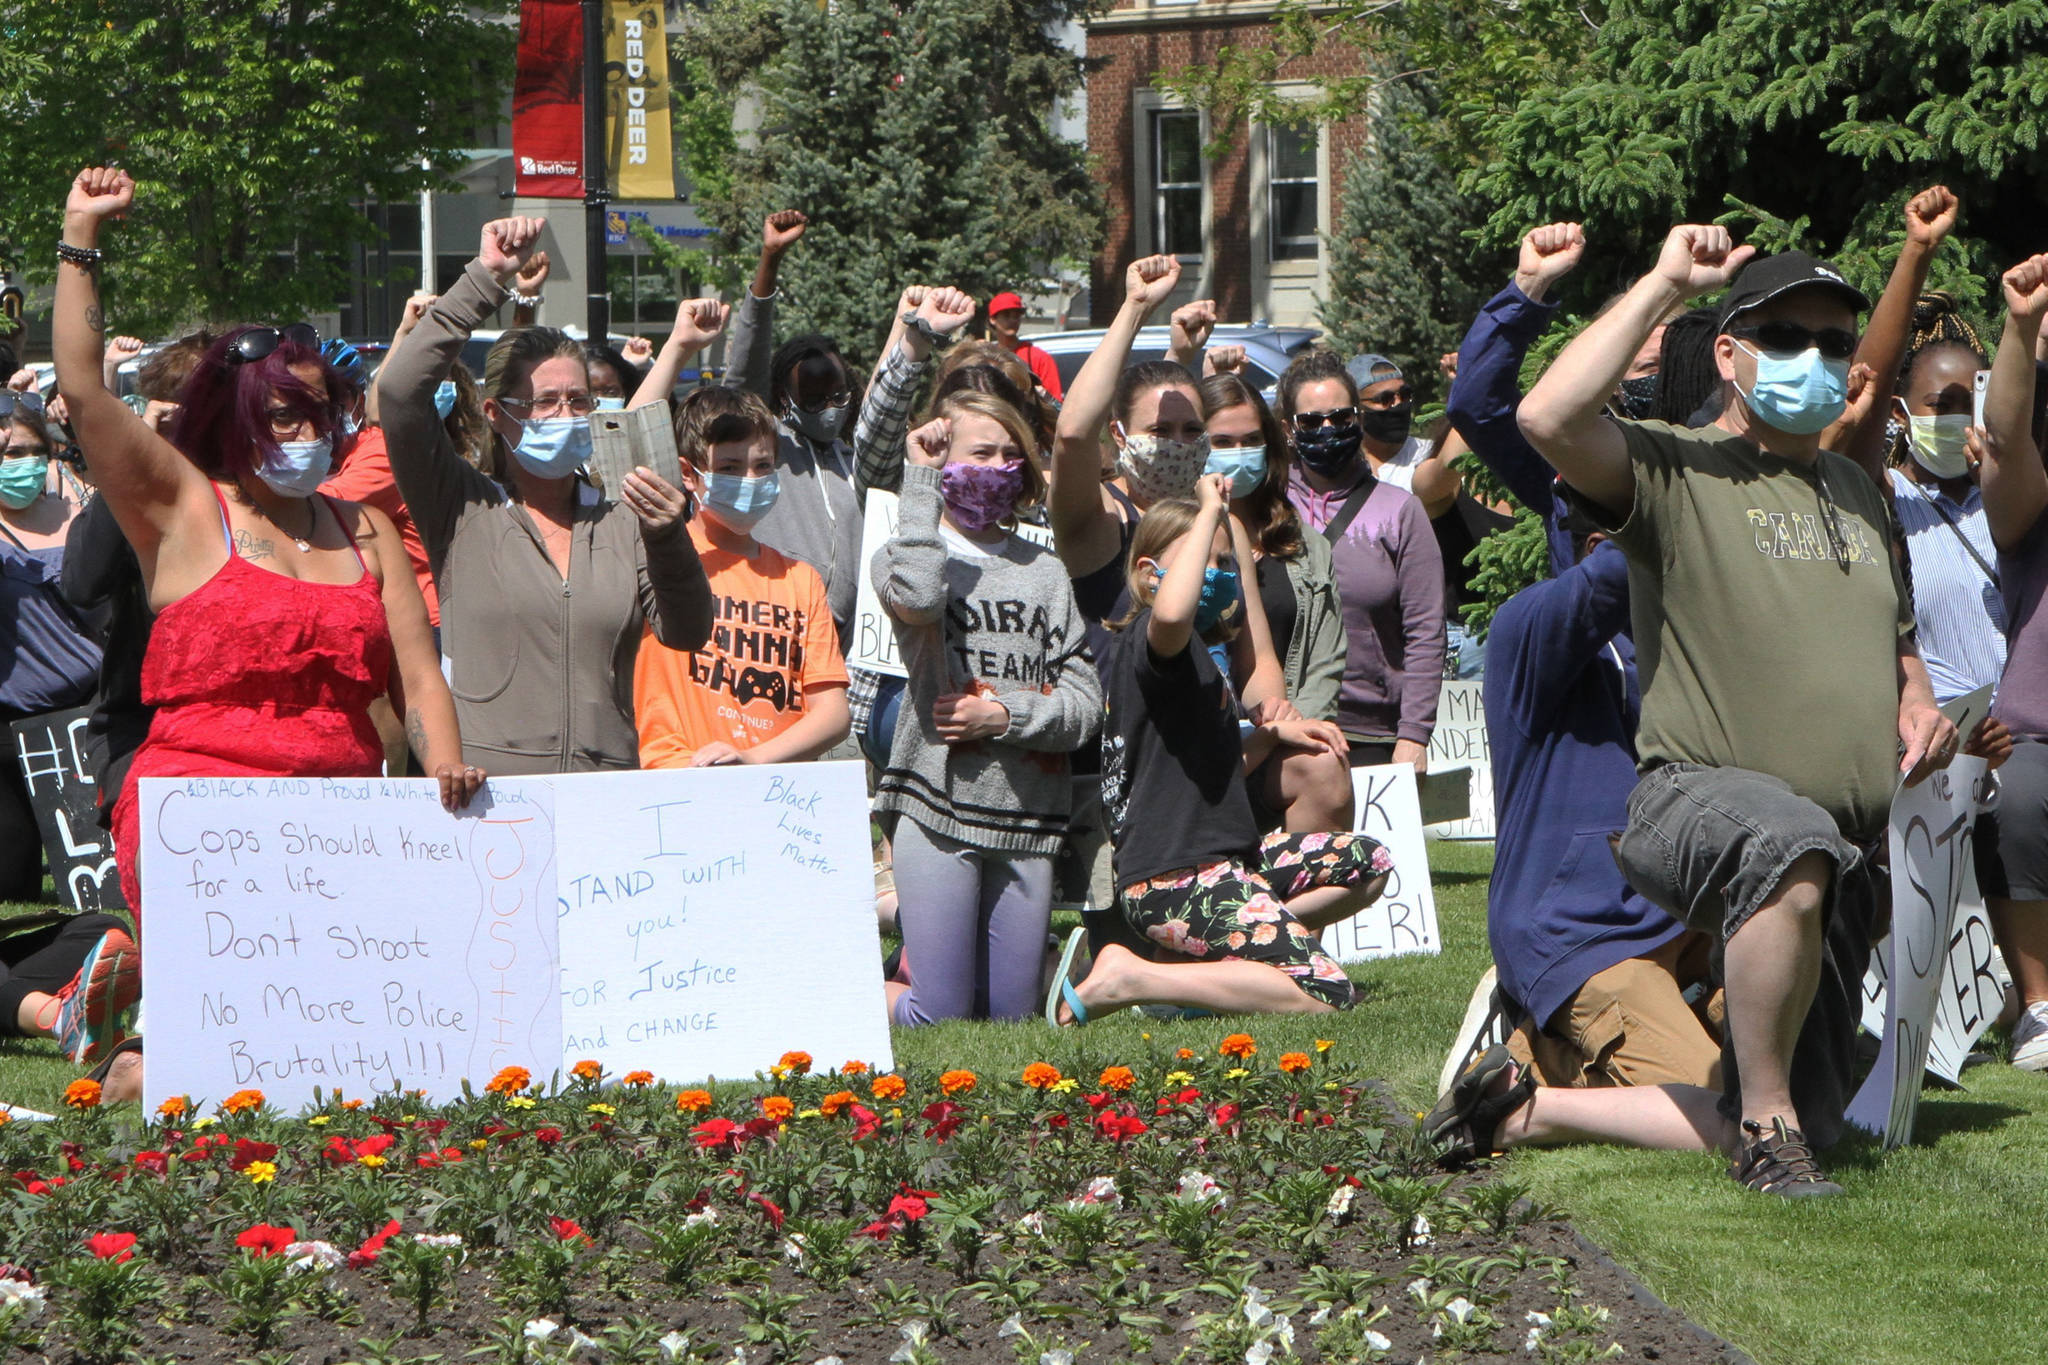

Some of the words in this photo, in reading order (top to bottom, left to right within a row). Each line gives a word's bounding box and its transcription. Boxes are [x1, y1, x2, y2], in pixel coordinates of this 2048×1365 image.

[625, 20, 644, 79] RED
[627, 87, 647, 165] DEER
[537, 164, 555, 174] Red
[556, 164, 577, 175] Deer
[266, 779, 310, 798] AND
[319, 777, 370, 801] Proud
[393, 781, 439, 801] White
[763, 775, 823, 818] Black
[157, 789, 261, 866] Cops
[279, 822, 383, 858] Should
[640, 801, 692, 861] I
[777, 811, 822, 845] Lives
[186, 858, 229, 899] for
[243, 878, 263, 893] a
[683, 850, 745, 885] WITH
[780, 842, 838, 875] Matter
[205, 911, 302, 959] Don't
[327, 924, 429, 961] Shoot
[484, 817, 535, 1077] JUSTIC
[629, 958, 737, 1001] Justice
[201, 991, 238, 1030] No
[263, 983, 366, 1025] More
[382, 981, 468, 1032] Police
[564, 1025, 609, 1054] And
[626, 1012, 719, 1043] CHANGE
